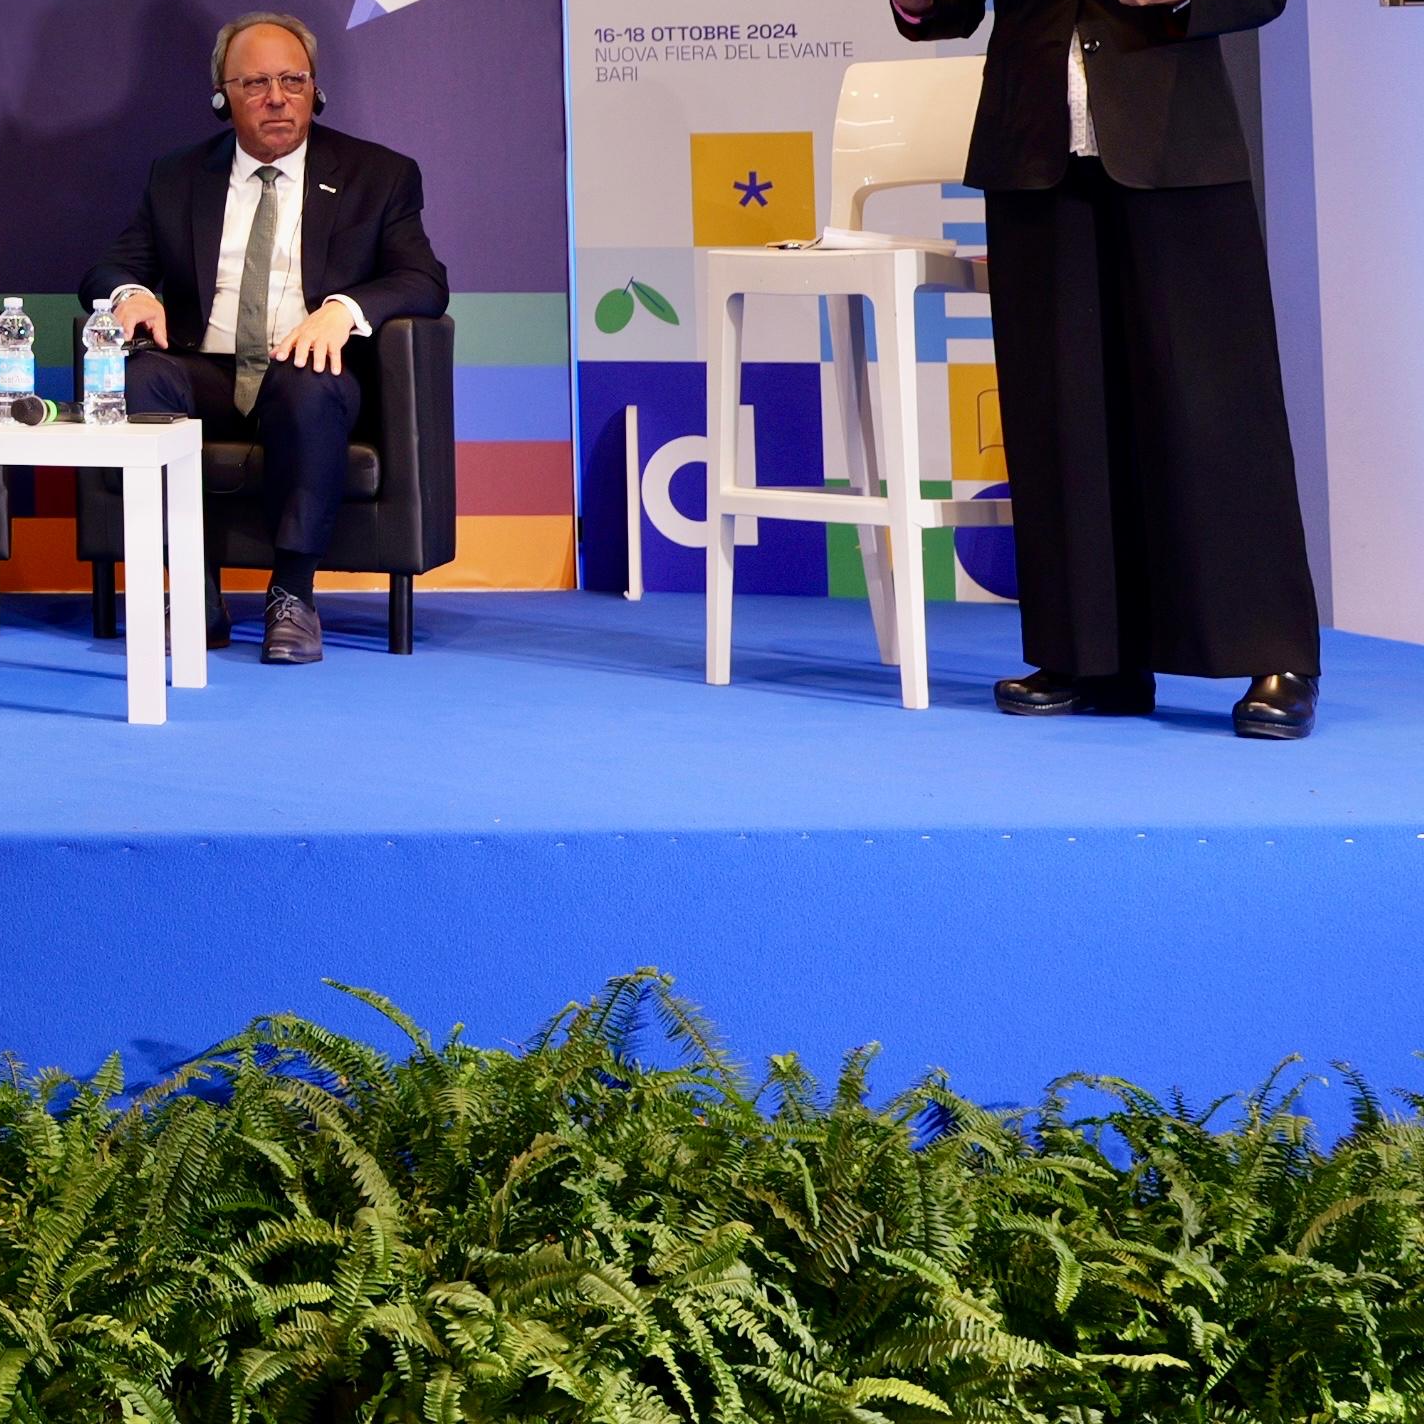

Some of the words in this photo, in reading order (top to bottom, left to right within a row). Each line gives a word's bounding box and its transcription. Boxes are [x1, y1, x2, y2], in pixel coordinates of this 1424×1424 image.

[594, 28, 645, 43] 16-18
[651, 26, 741, 42] OTTOBRE
[747, 24, 798, 40] 2024
[595, 45, 659, 62] NUOVA
[665, 44, 718, 61] FIERA
[724, 43, 761, 60] DEL
[765, 41, 853, 59] LEVANTE
[595, 67, 638, 83] BARI
